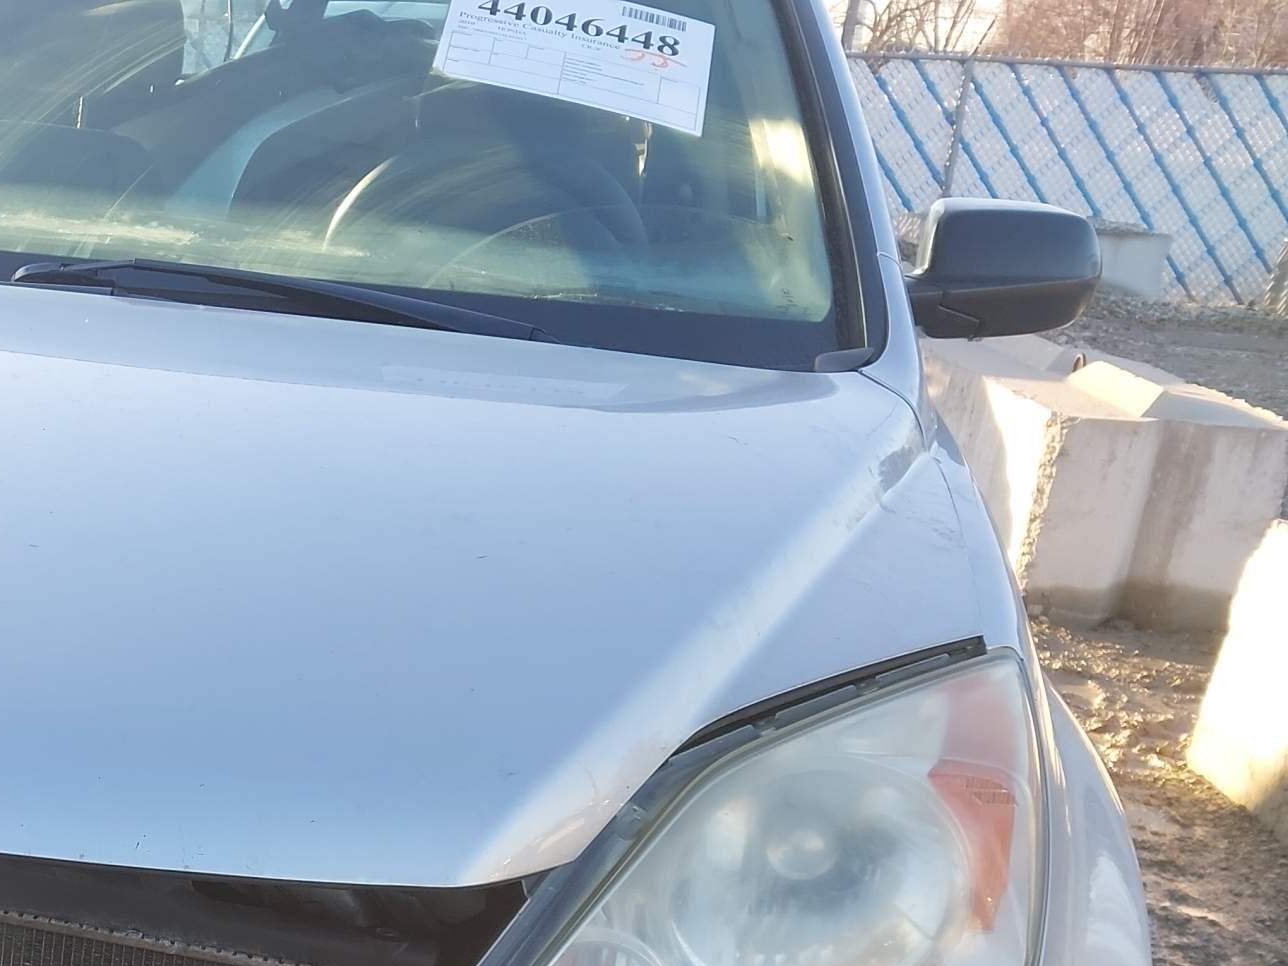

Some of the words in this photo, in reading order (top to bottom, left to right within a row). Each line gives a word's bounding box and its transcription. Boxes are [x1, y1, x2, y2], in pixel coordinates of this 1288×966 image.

[459, 11, 520, 28] Progressive
[522, 23, 567, 38] Casualty
[571, 33, 621, 50] Insurance
[478, 0, 680, 57] 44046448
